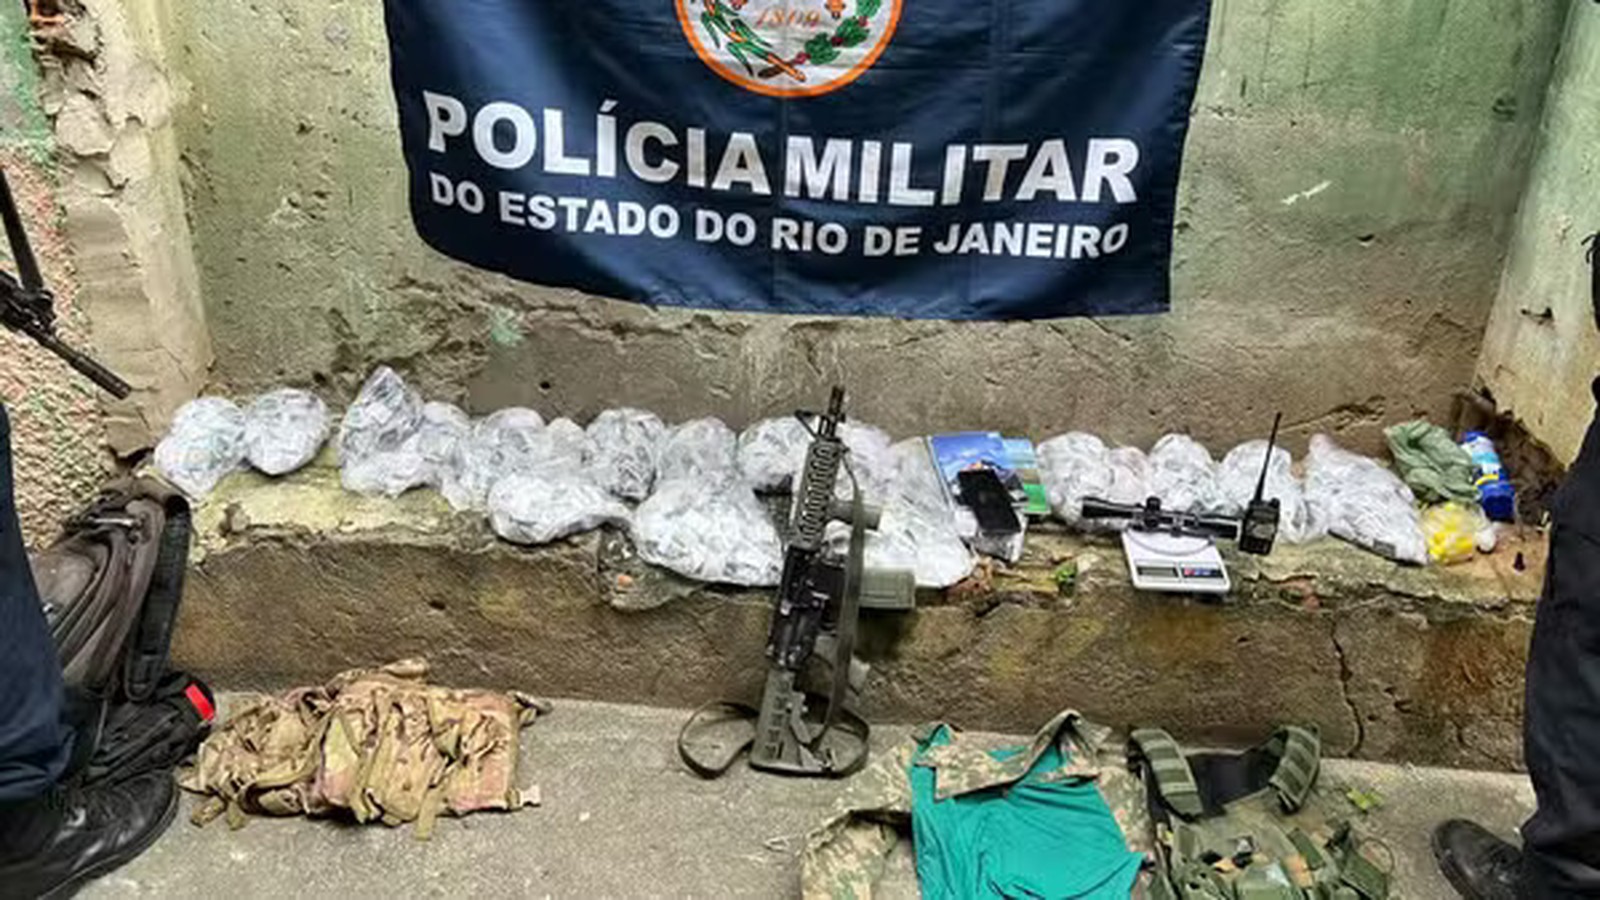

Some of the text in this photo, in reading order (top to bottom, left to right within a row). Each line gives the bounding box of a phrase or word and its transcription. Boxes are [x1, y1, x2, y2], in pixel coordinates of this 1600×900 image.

[423, 90, 1139, 206] POLÍCIA MILITAR
[430, 172, 1128, 260] DO ESTADO DO RIO DE JANEIRO
